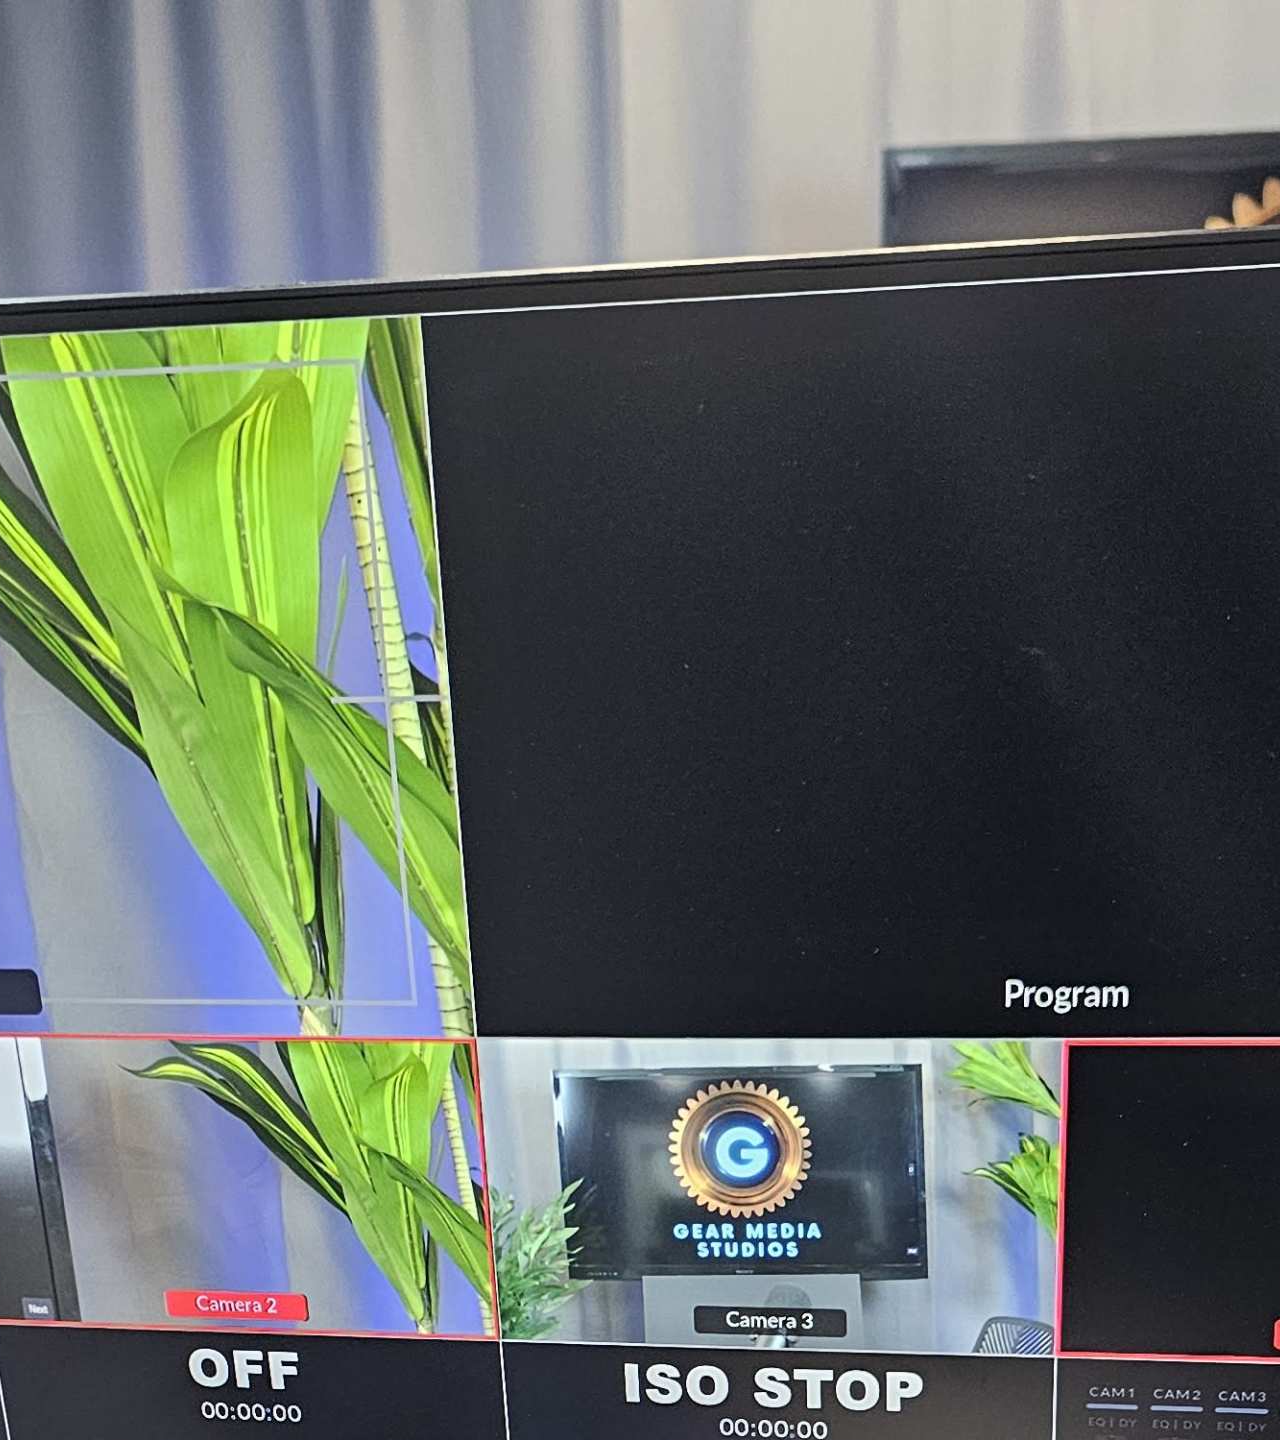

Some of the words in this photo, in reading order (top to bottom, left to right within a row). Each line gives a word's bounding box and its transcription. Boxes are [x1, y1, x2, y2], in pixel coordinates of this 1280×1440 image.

[1004, 978, 1130, 1014] Program
[715, 1126, 769, 1178] G
[673, 1223, 735, 1242] GEAR
[746, 1222, 822, 1240] MEDIA
[697, 1240, 799, 1259] STUDIOS
[196, 1295, 263, 1314] Camera
[267, 1297, 277, 1314] 2
[725, 1310, 797, 1330] Camera
[801, 1312, 813, 1330] 3
[188, 1348, 299, 1390] OFF
[624, 1362, 729, 1406] ISO
[753, 1366, 923, 1412] STOP
[1089, 1387, 1135, 1398] CAM1
[1153, 1389, 1201, 1400] CAM2
[1218, 1391, 1266, 1402] CAM3
[201, 1401, 301, 1423] 00:00:00
[719, 1417, 828, 1440] 00:00:00
